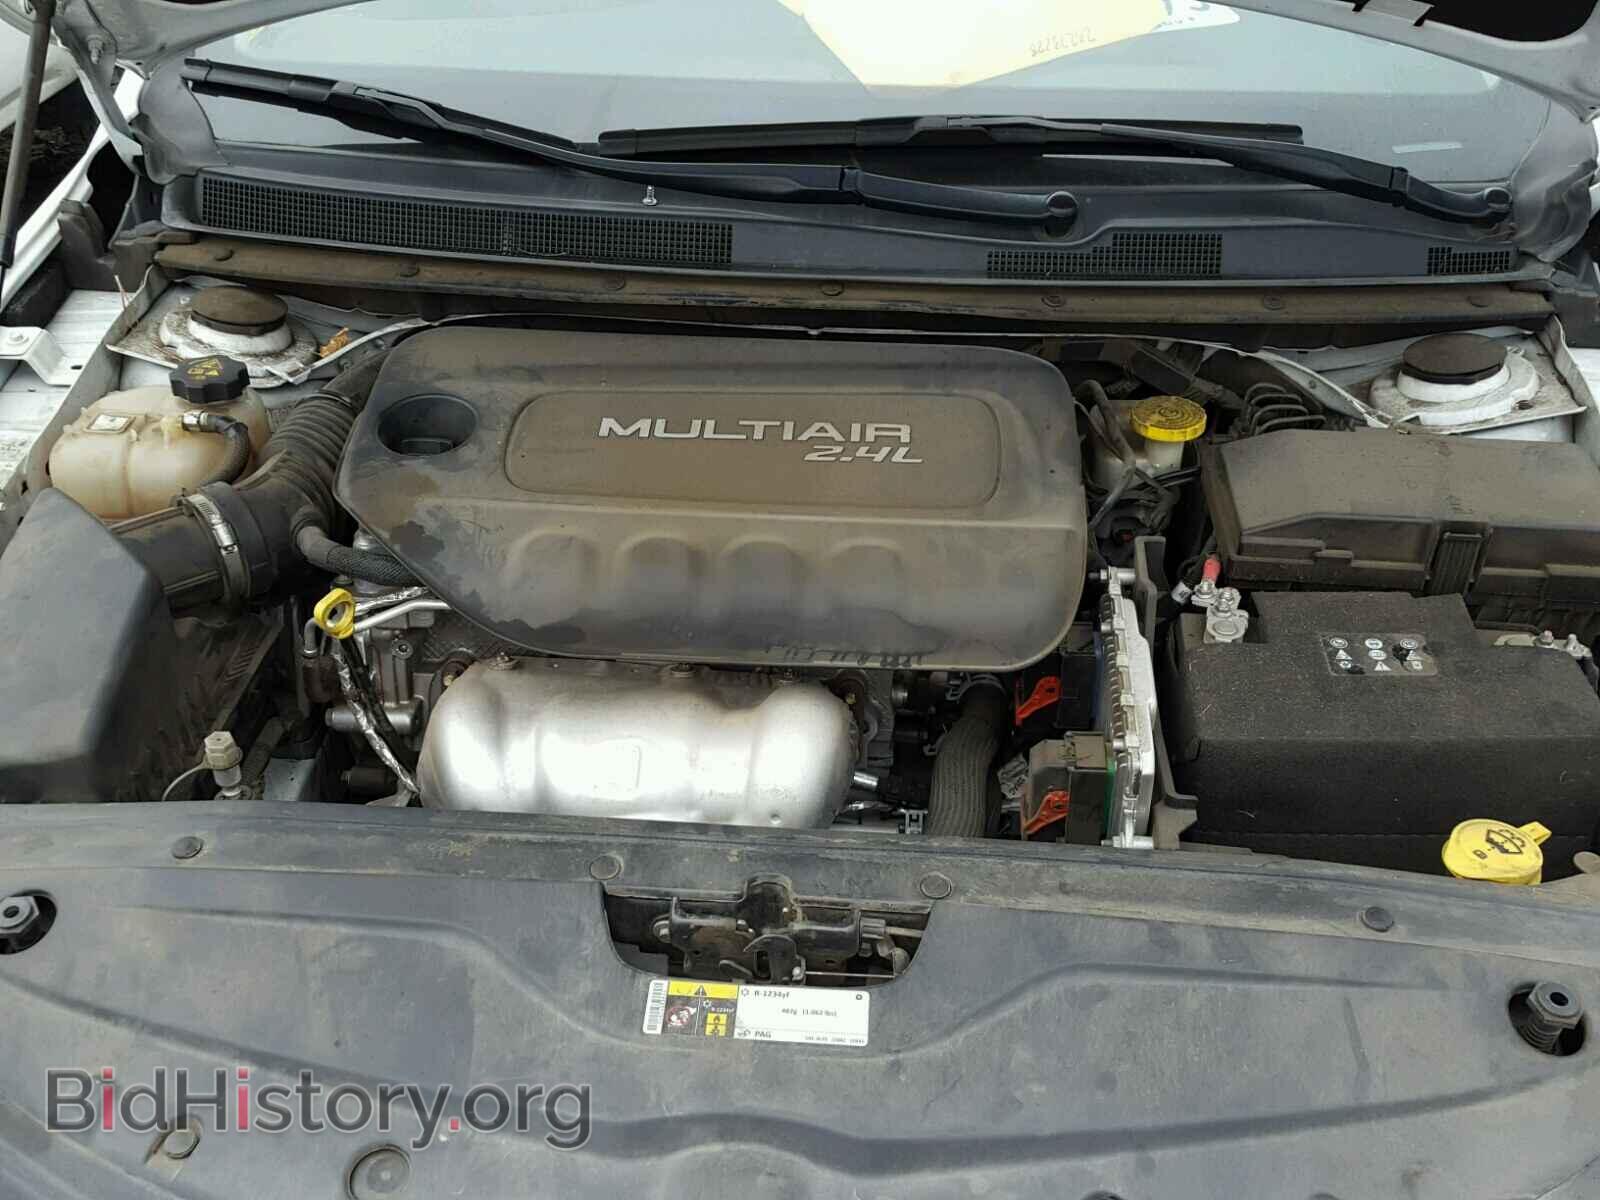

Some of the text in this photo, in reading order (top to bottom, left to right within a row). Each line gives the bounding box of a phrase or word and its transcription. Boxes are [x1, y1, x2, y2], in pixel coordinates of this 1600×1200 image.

[598, 417, 912, 443] MULTIAIR
[803, 445, 923, 464] 2.4L
[754, 1030, 772, 1039] PAG
